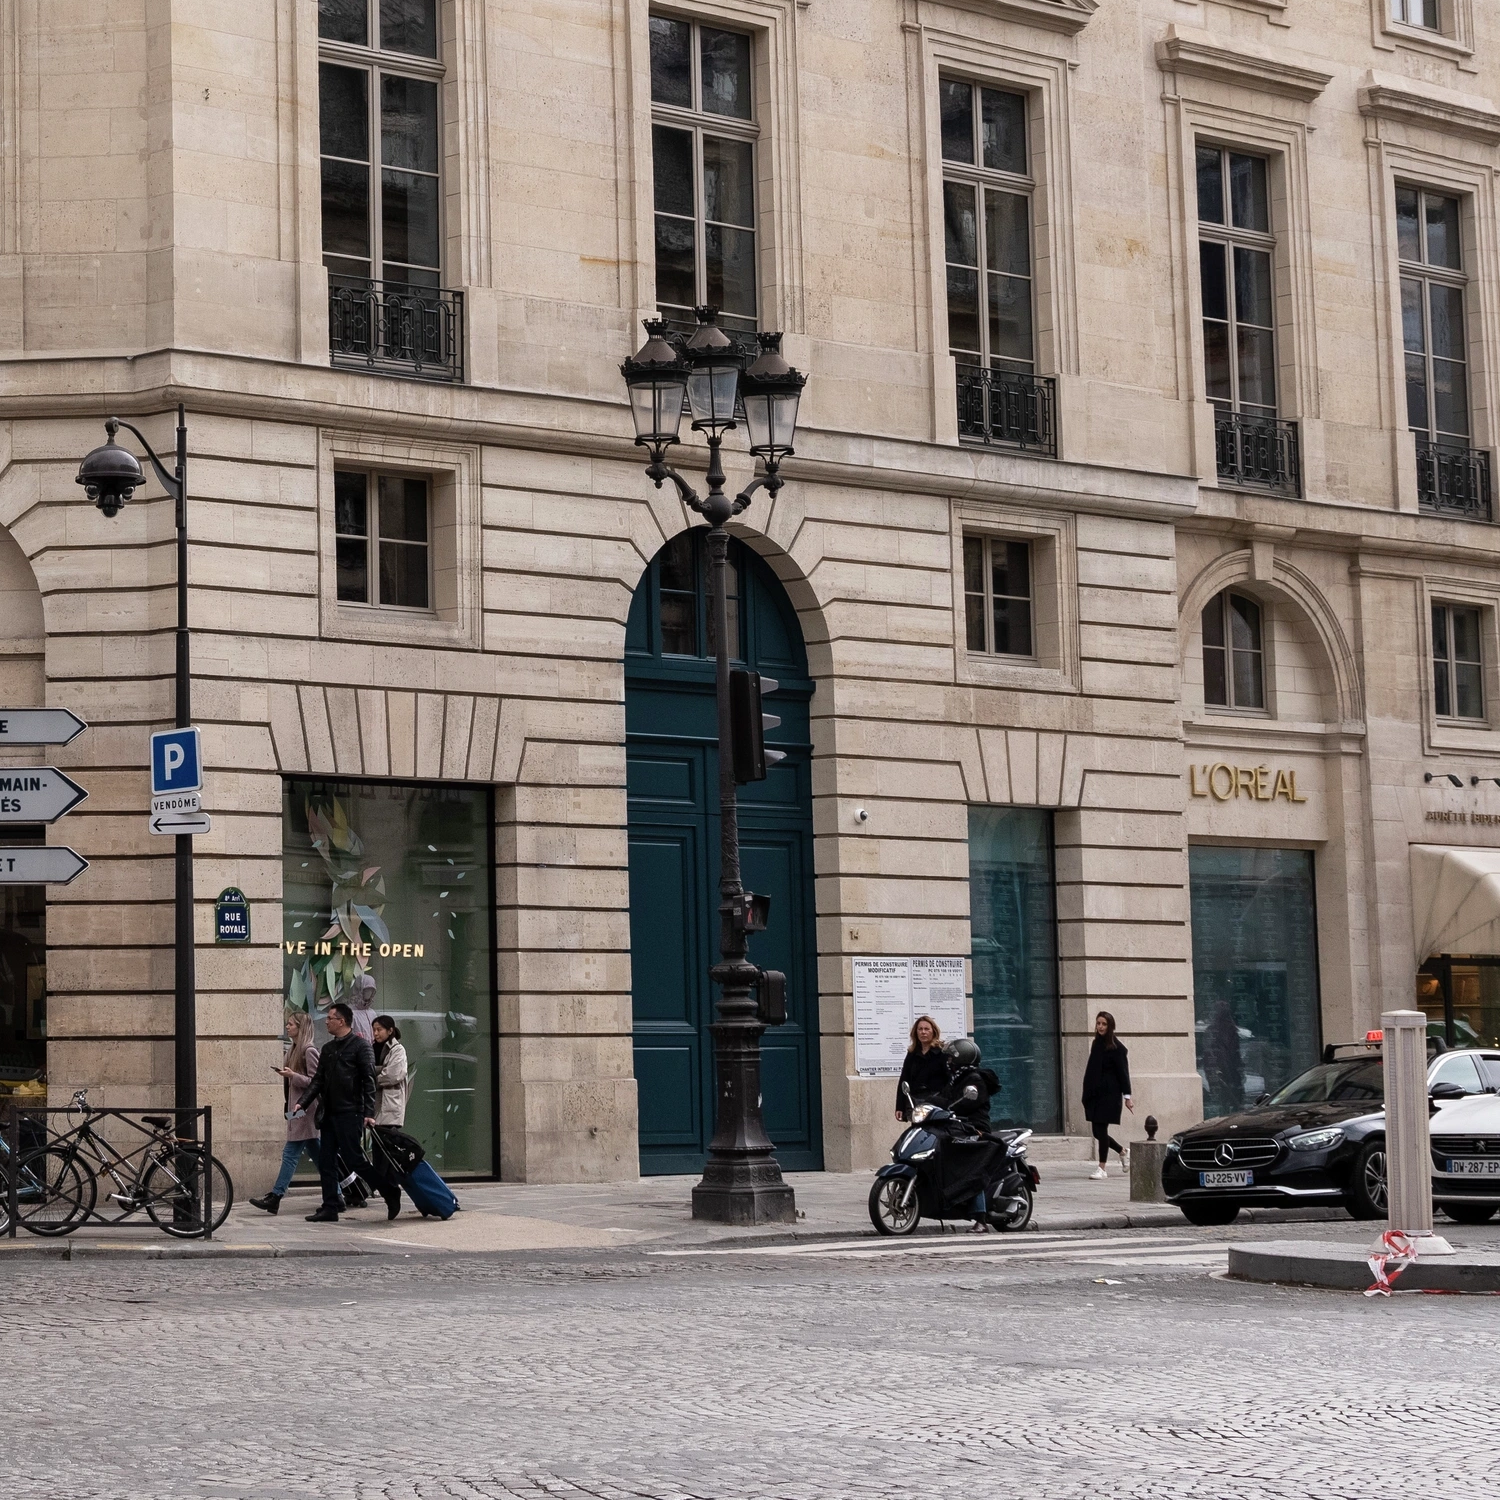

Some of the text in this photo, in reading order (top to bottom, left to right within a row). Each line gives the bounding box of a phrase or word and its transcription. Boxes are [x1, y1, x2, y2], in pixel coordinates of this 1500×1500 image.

[164, 743, 185, 781] P
[1189, 762, 1308, 803] L'ORÉAL
[154, 797, 197, 811] VENDÔME
[224, 912, 241, 921] RUE
[220, 925, 246, 934] ROYALE
[314, 941, 331, 956] IN
[339, 942, 372, 957] THE
[379, 943, 424, 958] OPEN
[1454, 1161, 1499, 1173] DW-287-EP
[1205, 1172, 1246, 1184] GJ-225-VV
